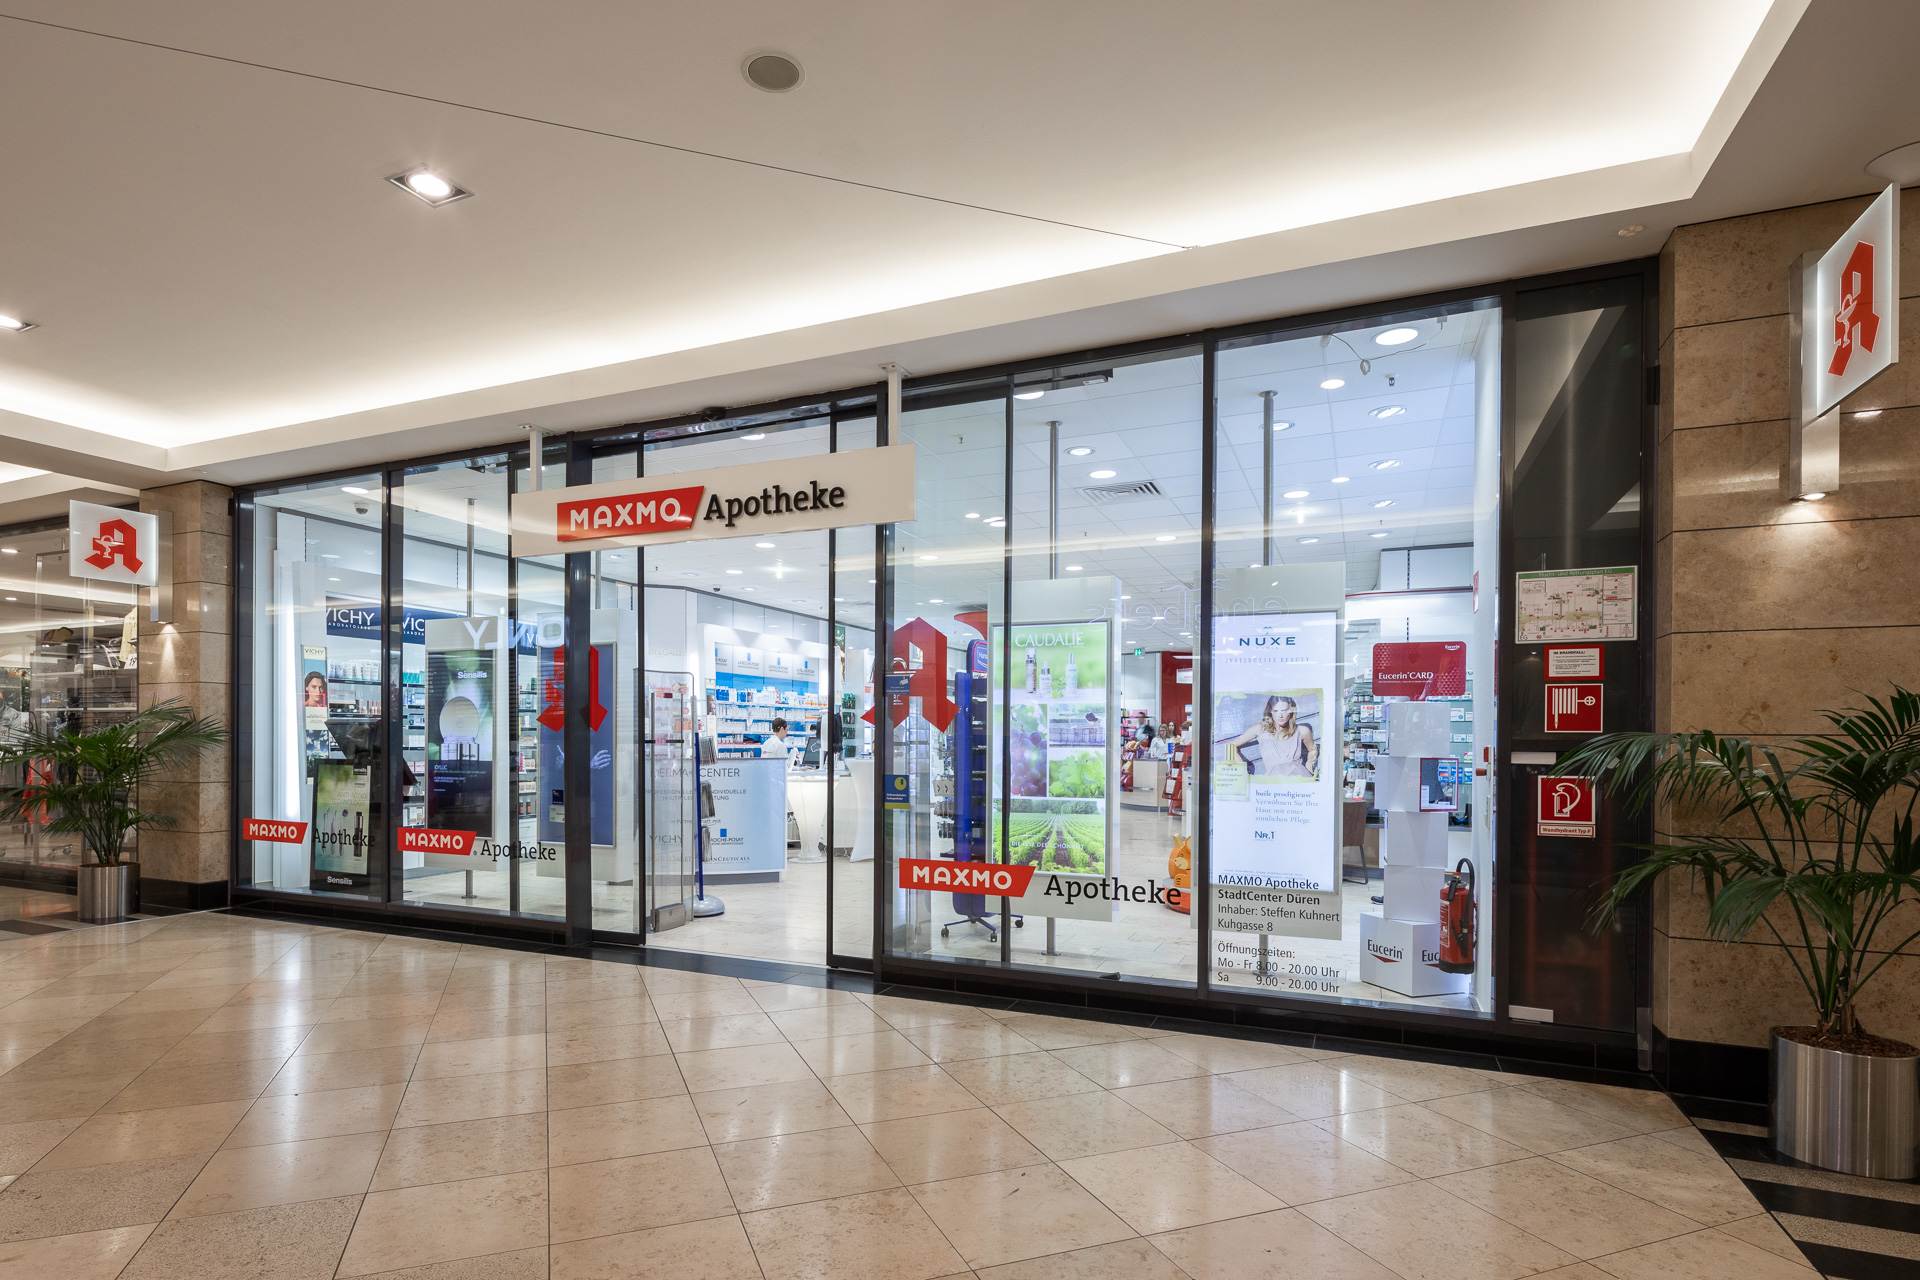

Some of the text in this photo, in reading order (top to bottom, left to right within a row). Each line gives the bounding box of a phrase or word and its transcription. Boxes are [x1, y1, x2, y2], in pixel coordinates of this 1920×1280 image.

[570, 480, 845, 532] MAXMO Apotheke
[327, 622, 371, 631] ABORATOIRES
[402, 618, 425, 632] VIC
[1239, 636, 1296, 646] NUXE
[457, 671, 488, 680] Sensilis
[700, 768, 740, 778] CENTER
[249, 823, 375, 848] MAXMO Apotheke
[405, 832, 556, 861] MAXMO Apotheke
[327, 876, 353, 886] Sensilis
[912, 865, 1182, 906] MAXMO Apotheke
[1218, 875, 1319, 890] MAXMO Apotheke
[1218, 889, 1320, 905] StadtCenter Düren
[1218, 904, 1340, 922] Inhaber: Steffen Kuhnert
[1218, 918, 1273, 932] Kuhgasse 8
[1218, 940, 1295, 959] Öffnungszeiten:
[1367, 939, 1403, 960] Eucerin
[1421, 949, 1440, 962] Euc
[1218, 957, 1234, 967] Mo
[1243, 960, 1253, 969] Fr
[1256, 961, 1278, 972] 8.00
[1288, 964, 1318, 976] 20.00
[1321, 966, 1340, 978] Uhr
[1218, 972, 1229, 982] Sa
[1256, 975, 1278, 987] 9.00
[1288, 979, 1318, 991] 20.00
[1321, 981, 1340, 993] Uhr
